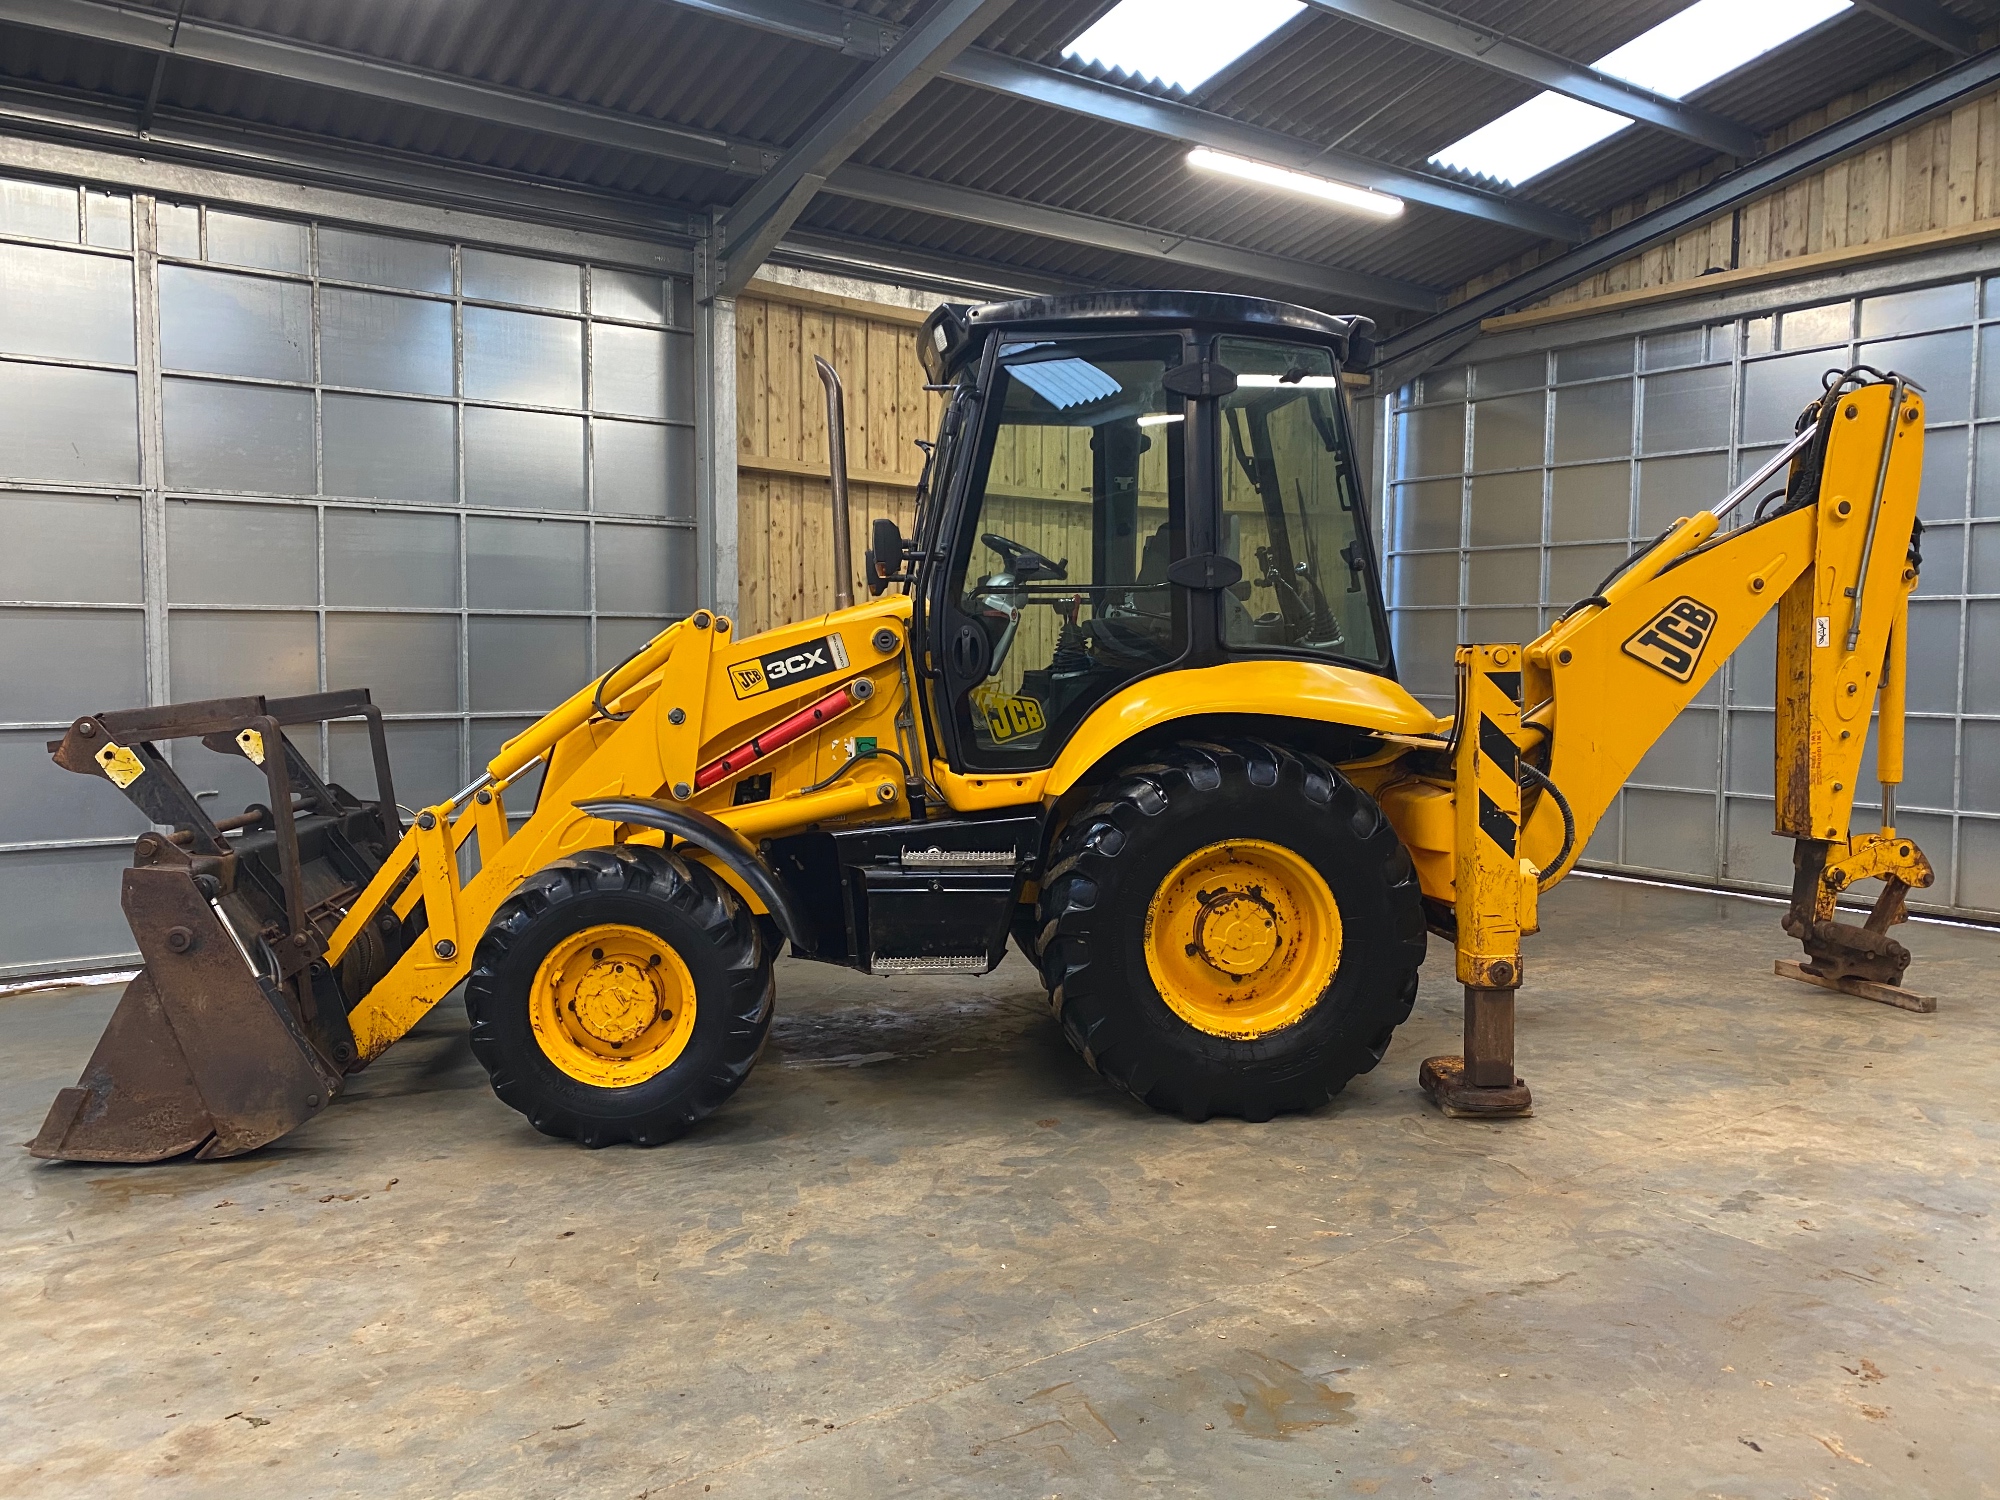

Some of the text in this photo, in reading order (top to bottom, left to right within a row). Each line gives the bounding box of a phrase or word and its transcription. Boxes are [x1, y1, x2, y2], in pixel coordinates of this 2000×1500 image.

[1637, 602, 1712, 674] JCB
[738, 670, 761, 689] JCB
[766, 648, 828, 680] 3CX
[990, 697, 1042, 738] JCB
